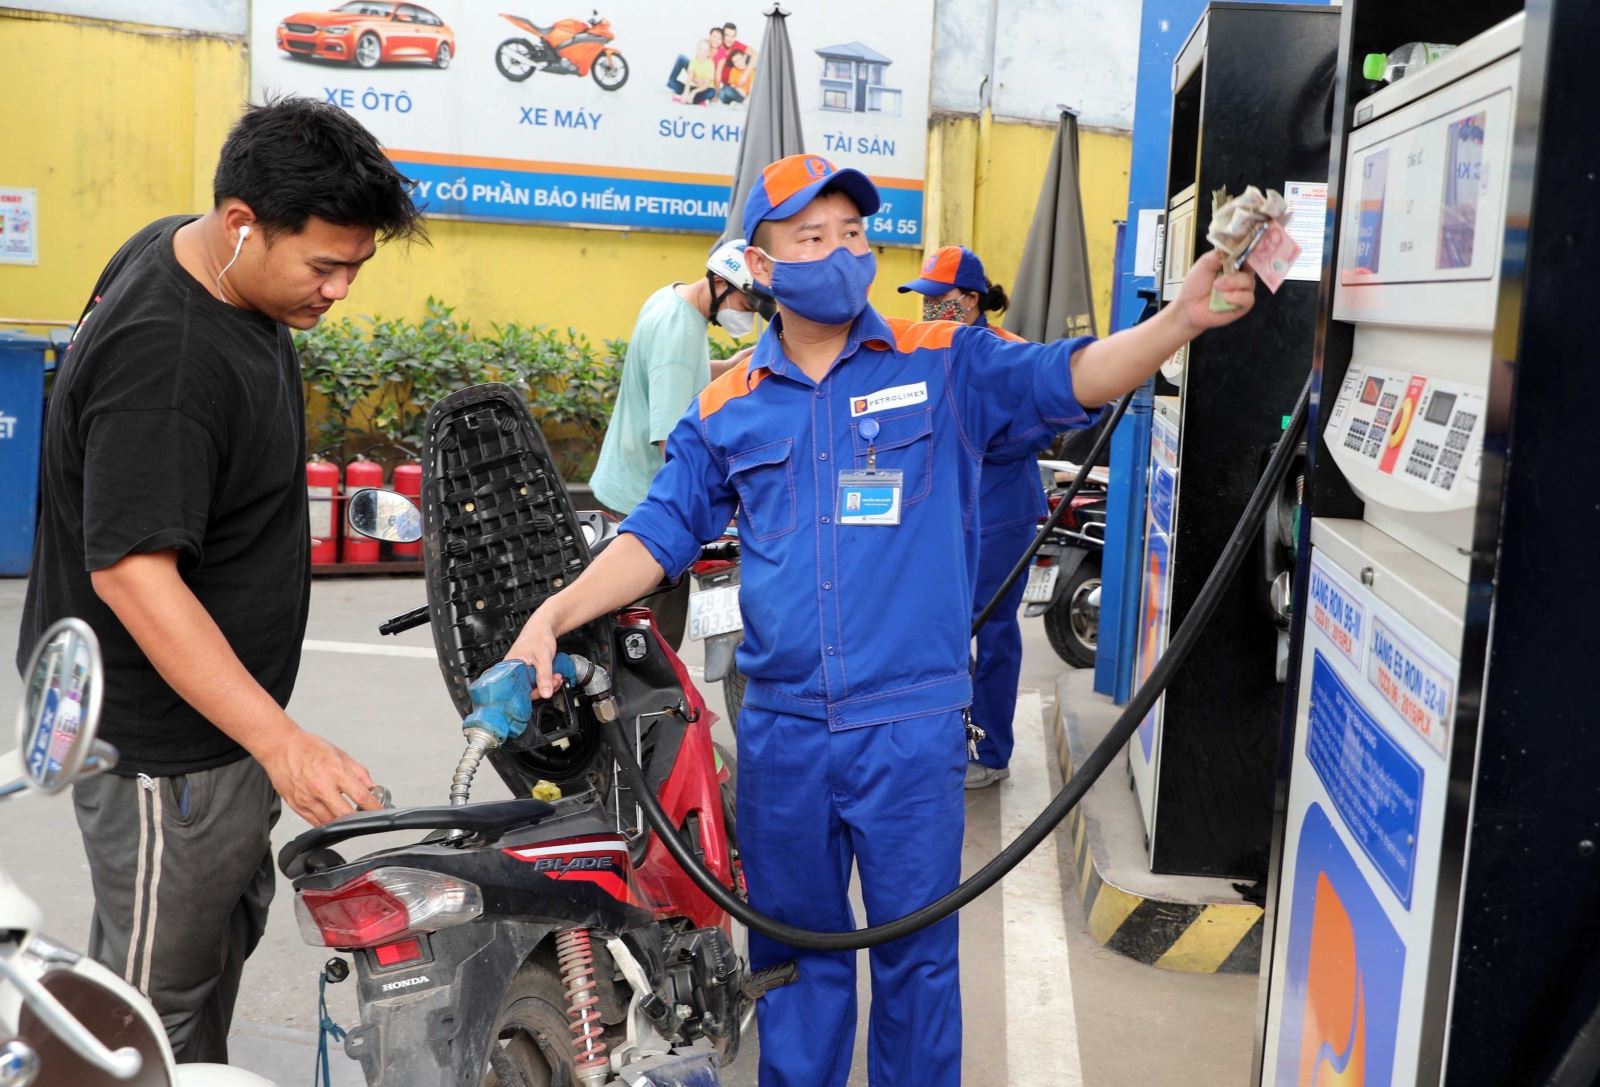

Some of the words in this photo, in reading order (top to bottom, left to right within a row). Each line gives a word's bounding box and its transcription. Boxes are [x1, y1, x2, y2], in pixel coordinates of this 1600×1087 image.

[323, 87, 355, 108] XE
[361, 86, 413, 113] ÔTÔ
[519, 106, 547, 126] XE
[554, 106, 603, 130] MÁY
[658, 116, 705, 139] SỨC
[711, 123, 741, 143] KH
[823, 130, 852, 153] TÀI
[857, 134, 896, 156] SẢN
[472, 180, 530, 206] PHẦN
[534, 185, 577, 208] BẢO
[581, 187, 631, 211] HIỂM
[873, 217, 894, 233] 54
[896, 219, 917, 235] 55
[869, 389, 926, 407] PETROLIMEX
[1393, 649, 1403, 680] E5
[1403, 659, 1423, 698] RON
[534, 856, 613, 876] BLADE
[381, 975, 431, 992] HONDA
